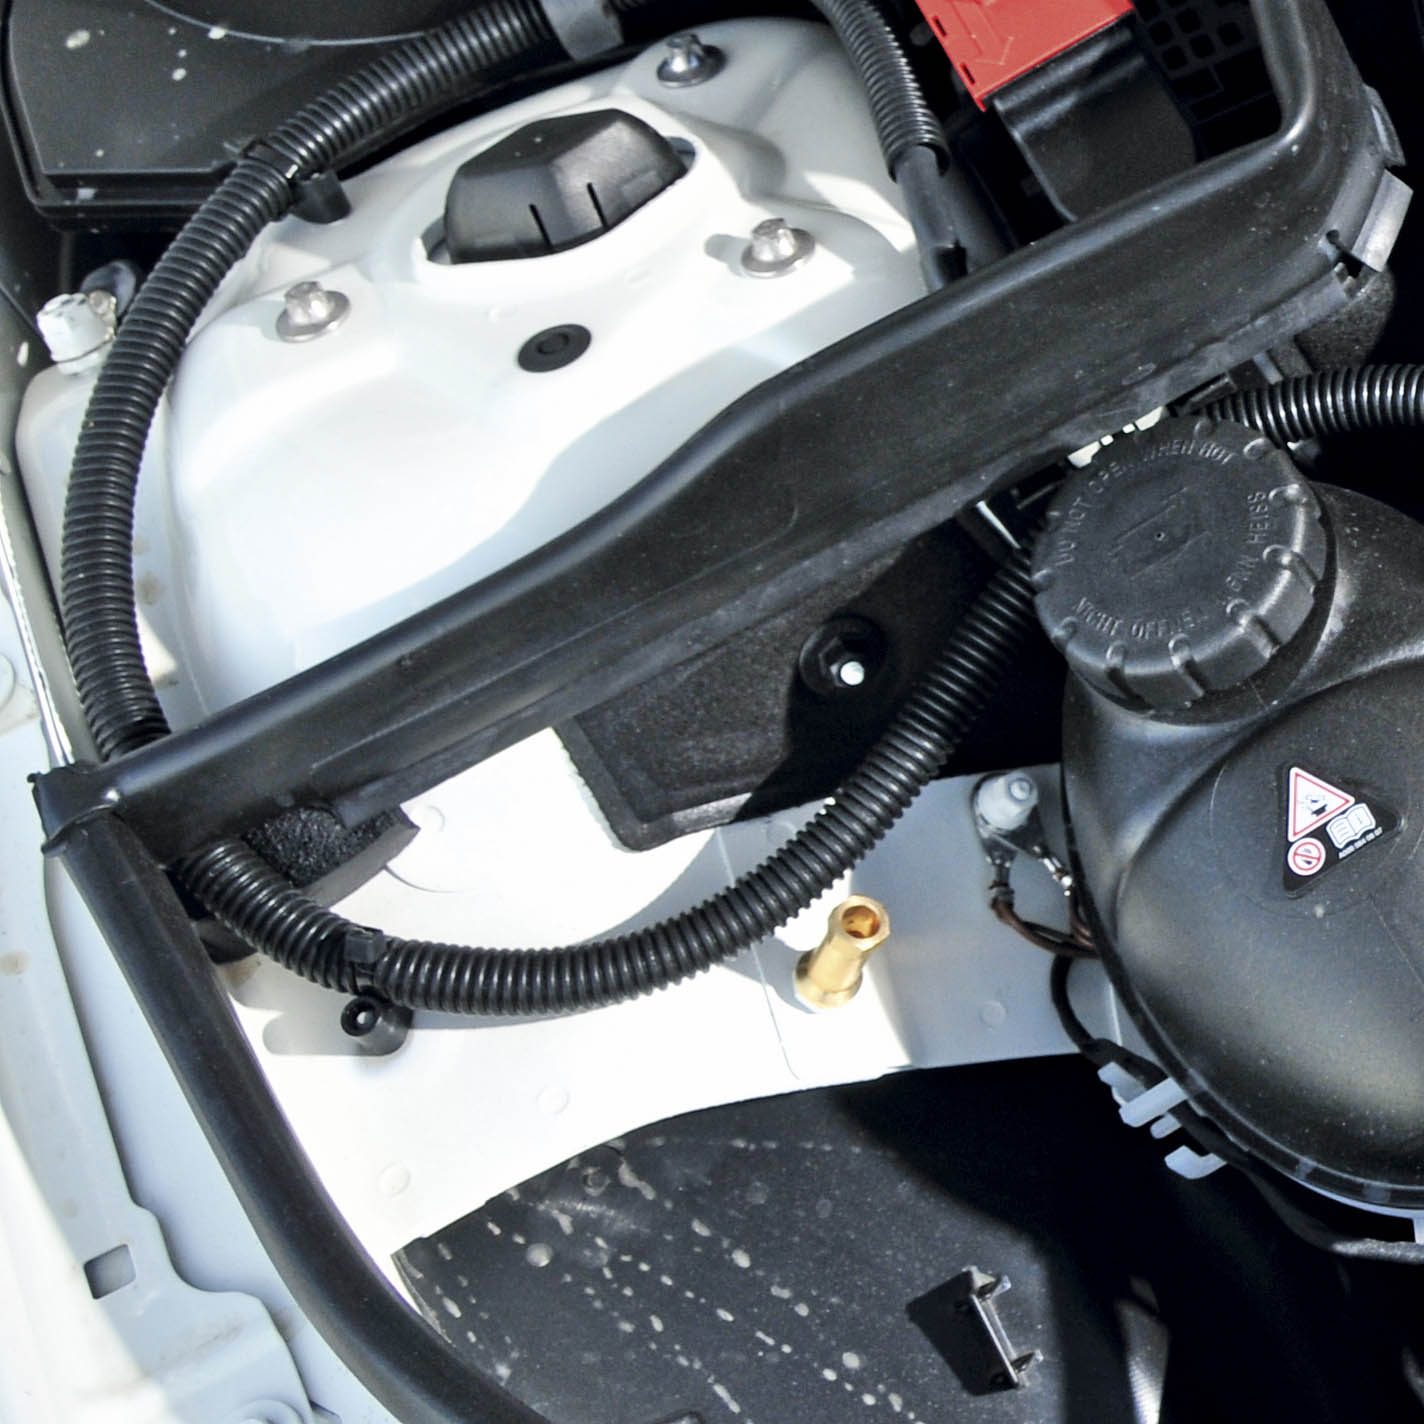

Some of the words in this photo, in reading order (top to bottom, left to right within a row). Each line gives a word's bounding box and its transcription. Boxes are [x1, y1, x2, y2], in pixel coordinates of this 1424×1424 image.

[1199, 441, 1238, 464] HOT
[1072, 597, 1123, 636] NICHT
[1247, 490, 1272, 545] HEISS
